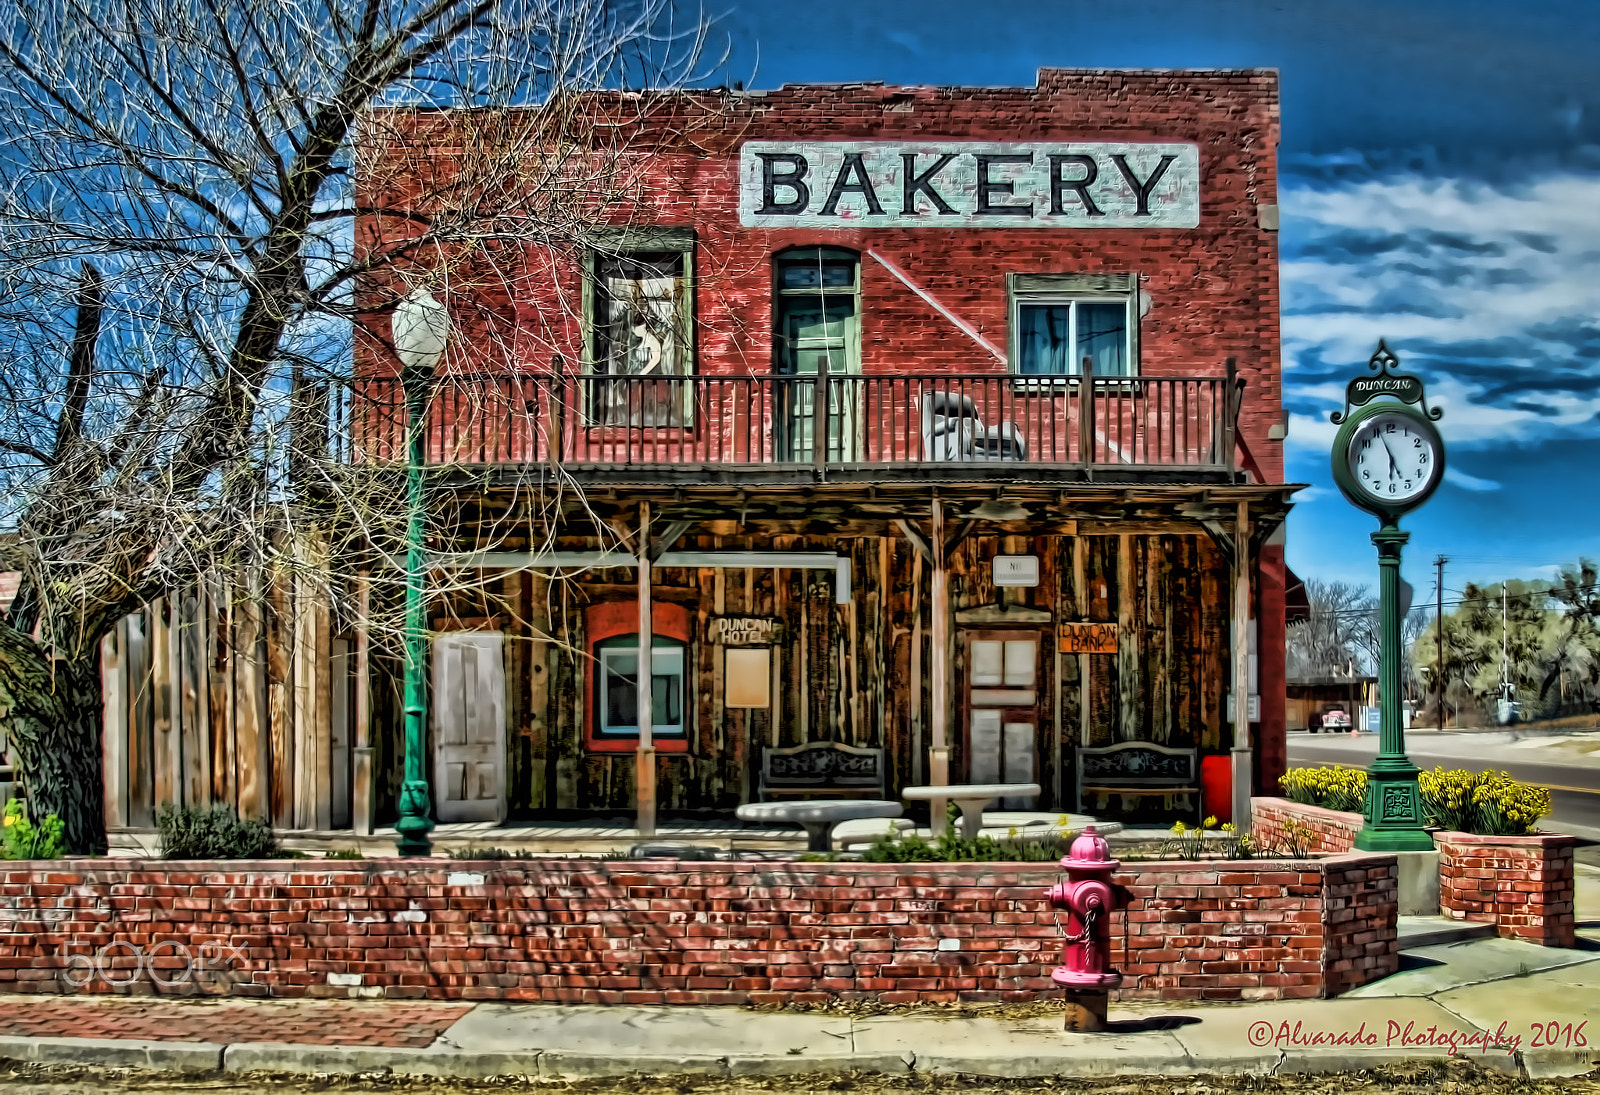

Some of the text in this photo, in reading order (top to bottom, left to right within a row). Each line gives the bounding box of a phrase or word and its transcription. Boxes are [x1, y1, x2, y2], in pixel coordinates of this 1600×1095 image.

[753, 152, 1178, 218] BAKERY
[1356, 380, 1411, 391] DUNCAN
[1373, 427, 1381, 439] 11
[1386, 423, 1396, 434] 12
[1361, 439, 1371, 449] 10
[1414, 438, 1421, 448] 2
[1357, 454, 1364, 464] 9
[1419, 453, 1426, 464] 3
[1362, 469, 1370, 480] 8
[1414, 468, 1422, 479] 4
[1373, 480, 1380, 490] 7
[1388, 483, 1396, 494] 6
[1404, 479, 1412, 490] 5
[719, 618, 772, 632] DUNCAN
[1058, 624, 1116, 638] DUNCAN
[721, 630, 767, 644] HOTEL
[1071, 637, 1104, 651] BANK
